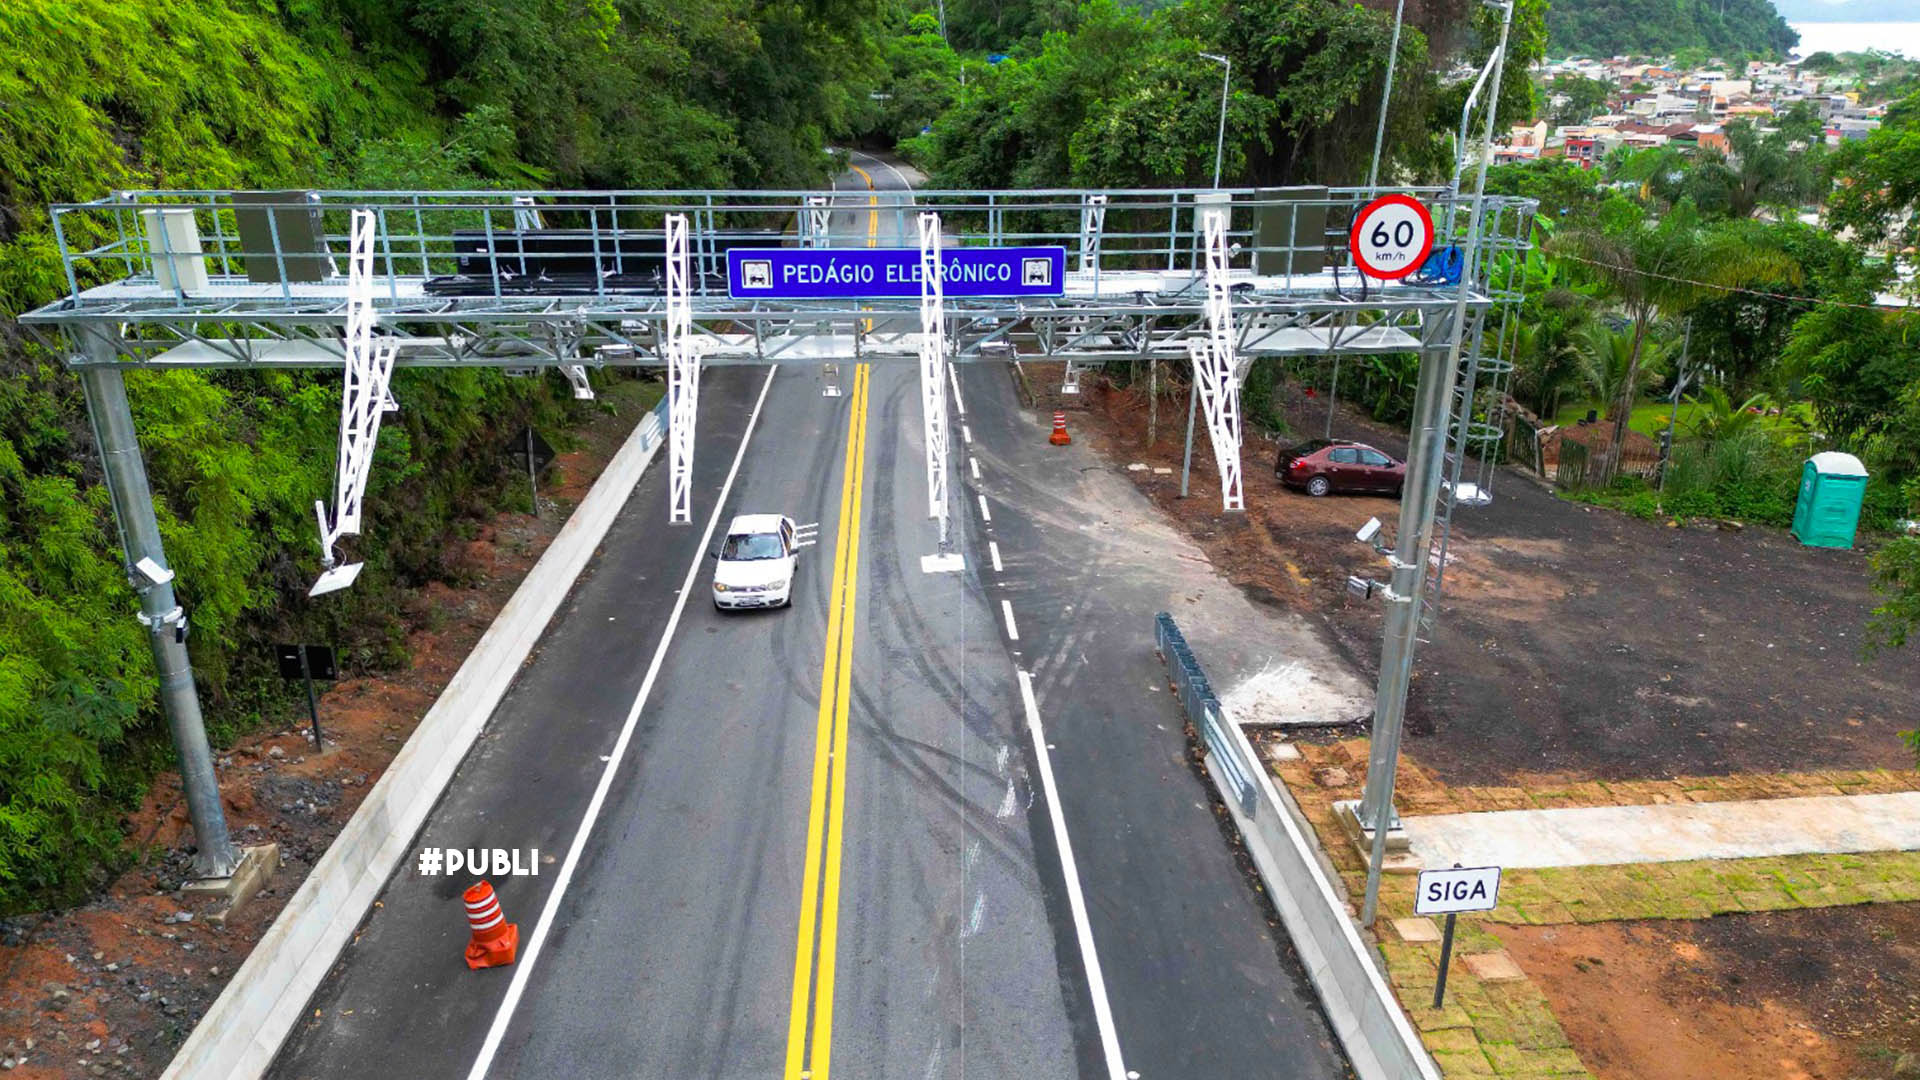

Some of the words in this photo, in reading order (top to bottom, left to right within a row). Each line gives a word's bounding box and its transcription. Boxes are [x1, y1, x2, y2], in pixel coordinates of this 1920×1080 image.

[1371, 220, 1414, 248] 60
[1375, 251, 1406, 262] km/h
[783, 257, 874, 284] PEDÁGIO
[886, 257, 1012, 283] ELERÔNICO
[1427, 879, 1487, 902] SIGA
